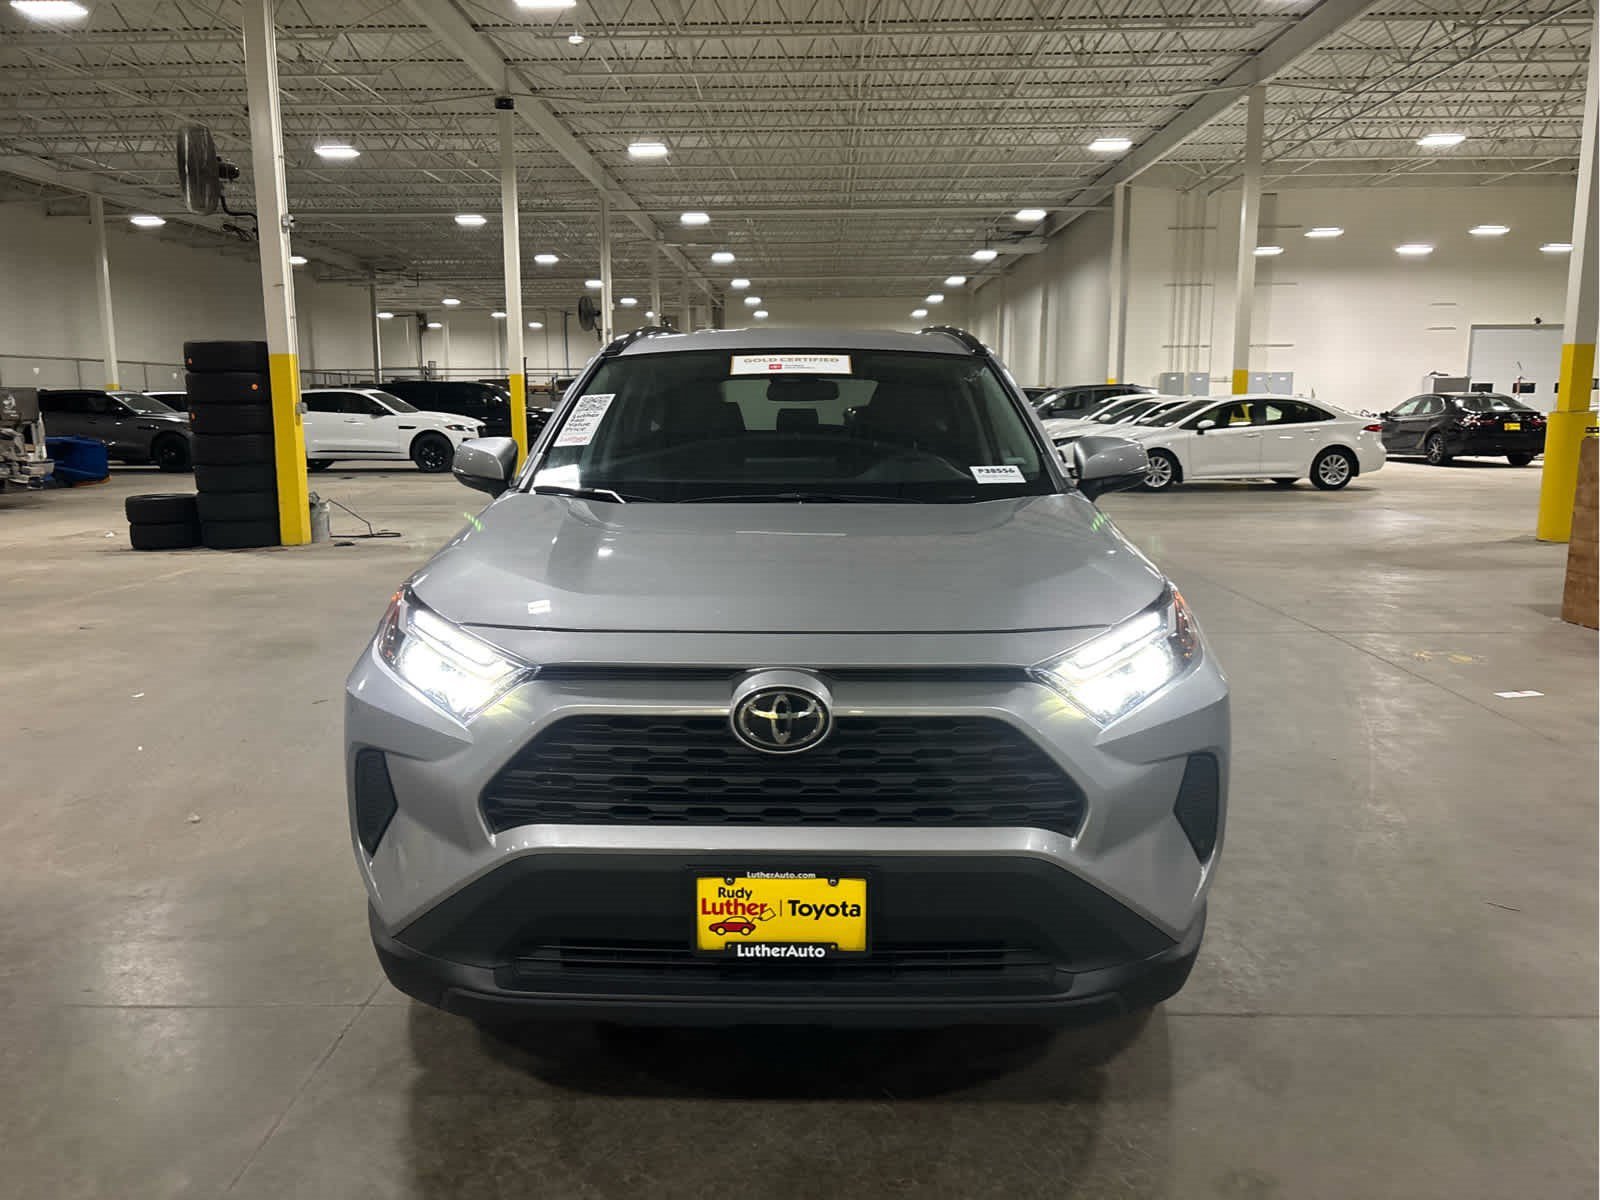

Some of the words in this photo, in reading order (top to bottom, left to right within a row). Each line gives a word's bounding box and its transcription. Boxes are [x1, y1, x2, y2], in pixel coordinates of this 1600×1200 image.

[746, 871, 817, 879] LutherAuto.com
[717, 887, 753, 901] Rudy
[701, 898, 768, 916] Luther
[787, 899, 862, 920] Toyota
[736, 944, 826, 958] LutherAuto
